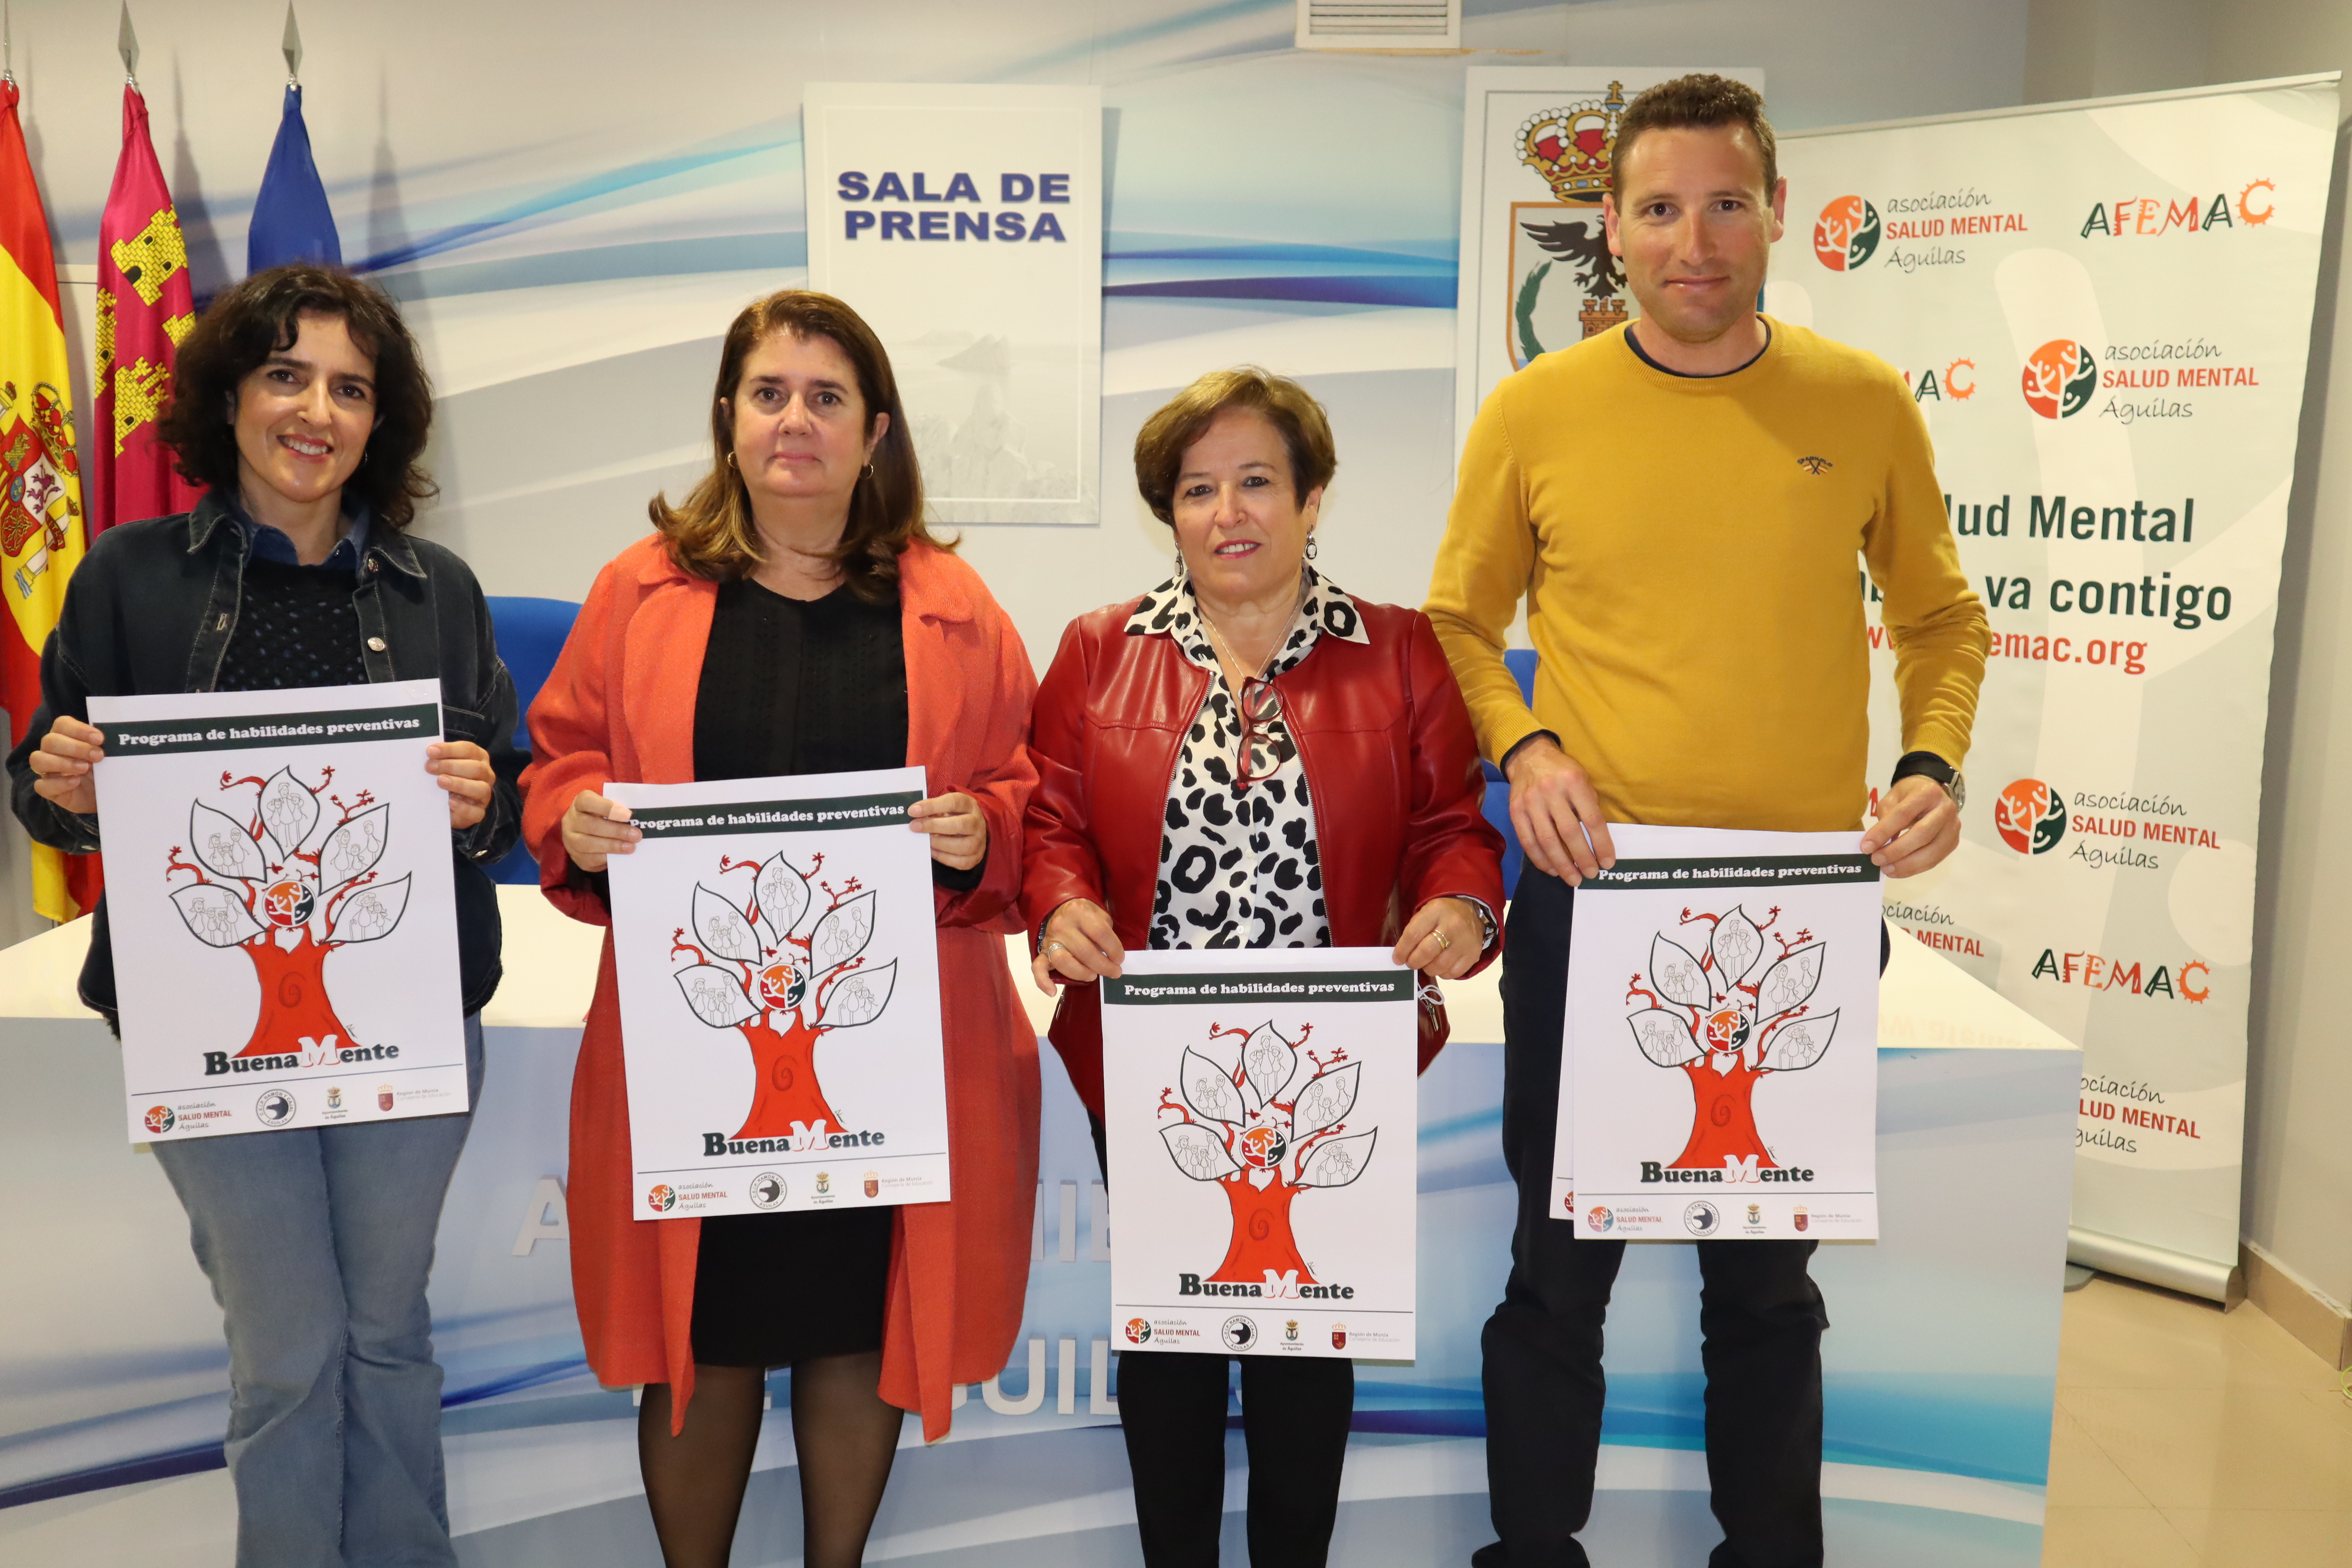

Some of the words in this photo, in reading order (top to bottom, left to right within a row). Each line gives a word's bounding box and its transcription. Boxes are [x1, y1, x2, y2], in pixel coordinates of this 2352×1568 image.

[837, 171, 981, 202] SALA
[1001, 172, 1070, 204] DE
[1887, 187, 1992, 213] asociación
[2080, 177, 2276, 239] AFEMAC
[845, 211, 1066, 243] PRENSA
[1886, 219, 1945, 241] SALUD
[1950, 214, 2028, 235] MENTAL
[1883, 246, 1966, 274] Águilas
[2105, 338, 2222, 361] asociación
[2102, 368, 2170, 389] SALUD
[2177, 367, 2259, 388] MENTAL
[2099, 398, 2193, 425] Águilas
[2029, 495, 2194, 543] Mental
[1985, 576, 2032, 610] va
[2050, 571, 2232, 630] contigo
[119, 730, 202, 746] Programa
[206, 730, 226, 740] de
[229, 724, 324, 739] habilidades
[326, 718, 420, 736] preventivas
[2073, 791, 2187, 817] asociación
[629, 817, 703, 831] Programa
[707, 815, 725, 826] de
[728, 811, 814, 824] habilidades
[816, 806, 904, 823] preventivas
[2072, 815, 2136, 838] SALUD
[2143, 821, 2221, 849] MENTAL
[2069, 841, 2160, 870] Águilas
[1599, 870, 1668, 882] Programa
[1672, 869, 1689, 879] de
[1692, 867, 1775, 878] habilidades
[1778, 864, 1861, 878] preventivas
[1917, 930, 1984, 957] MENTAL
[2031, 948, 2211, 1004] AFEMAC
[1124, 985, 1196, 998] Programa
[1200, 984, 1217, 994] de
[1220, 983, 1305, 994] habilidades
[1308, 982, 1394, 994] preventivas
[203, 1034, 399, 1076] BuenaMente
[2080, 1075, 2165, 1104] ociación
[178, 1101, 216, 1110] asociación
[178, 1113, 202, 1121] SALUD
[204, 1110, 232, 1119] MENTAL
[2079, 1099, 2116, 1120] LUD
[2122, 1106, 2200, 1139] MENTAL
[178, 1122, 209, 1131] Águilas
[703, 1119, 886, 1157] BuenaMente
[2076, 1128, 2137, 1152] guilas
[1640, 1154, 1814, 1184] BuenaMente
[678, 1181, 713, 1190] asociación
[678, 1203, 706, 1211] Águilas
[1178, 1269, 1354, 1299] BuenaMente
[1154, 1337, 1180, 1345] Águilas
